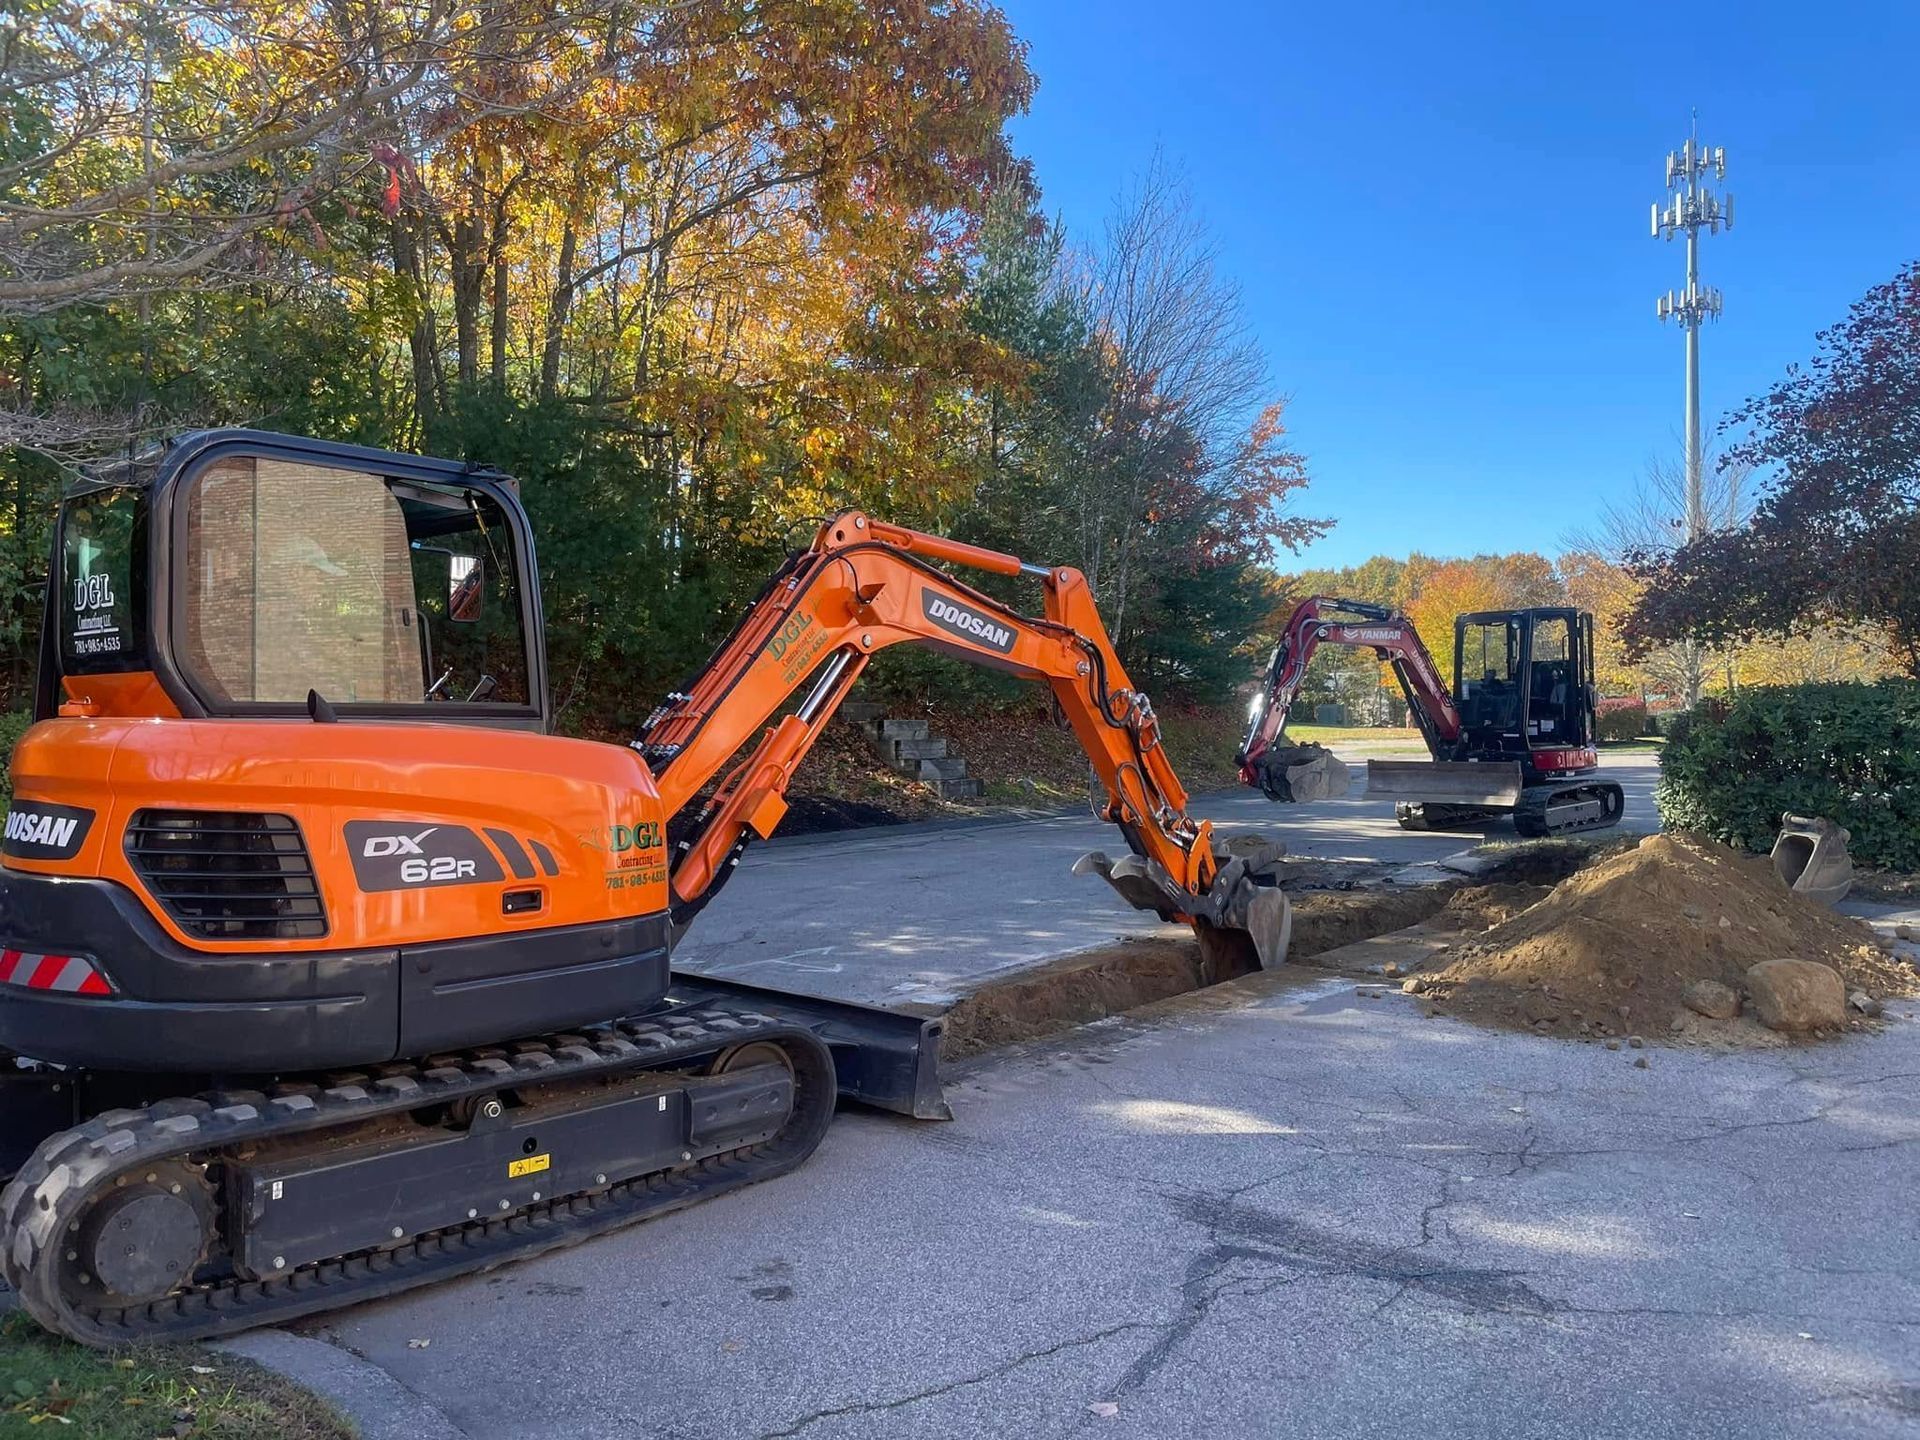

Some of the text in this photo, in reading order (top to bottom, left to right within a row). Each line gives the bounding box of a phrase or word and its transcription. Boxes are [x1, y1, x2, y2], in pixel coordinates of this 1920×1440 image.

[74, 573, 115, 611] DGL
[766, 610, 813, 662] DGL
[929, 599, 1010, 647] DOOSAN
[1360, 629, 1401, 640] YANMAR
[4, 811, 78, 848] OOSAN
[363, 827, 439, 857] DX
[609, 821, 663, 853] DGL
[401, 857, 476, 882] 62R
[616, 852, 653, 869] Contracting
